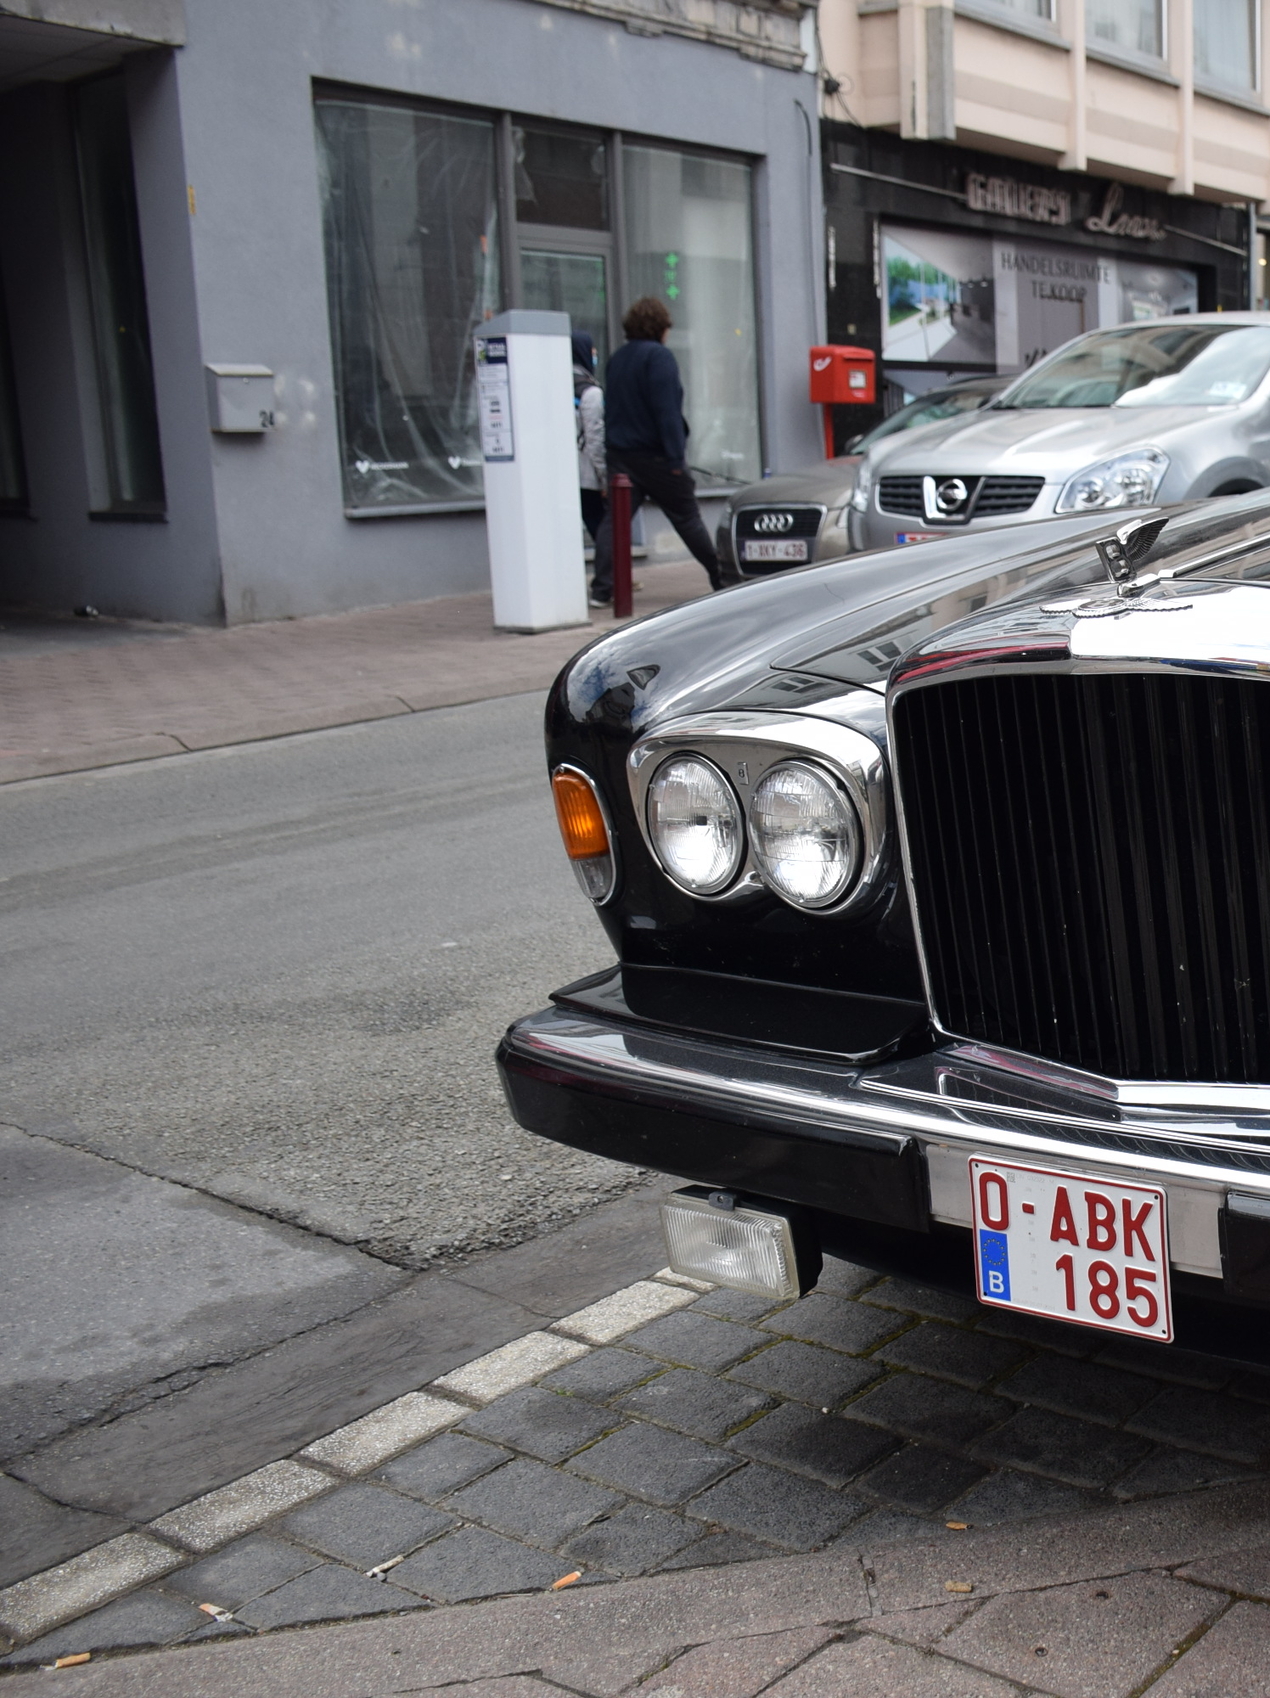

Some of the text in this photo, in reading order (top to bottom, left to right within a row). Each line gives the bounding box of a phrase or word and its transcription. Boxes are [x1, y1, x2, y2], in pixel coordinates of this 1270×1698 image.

[1000, 251, 1111, 285] HANDELSRUIMTE
[1031, 281, 1047, 299] TE
[259, 410, 275, 428] 24
[979, 1171, 1156, 1262] O-ABK
[989, 1270, 1005, 1294] B
[1055, 1253, 1159, 1328] 185
